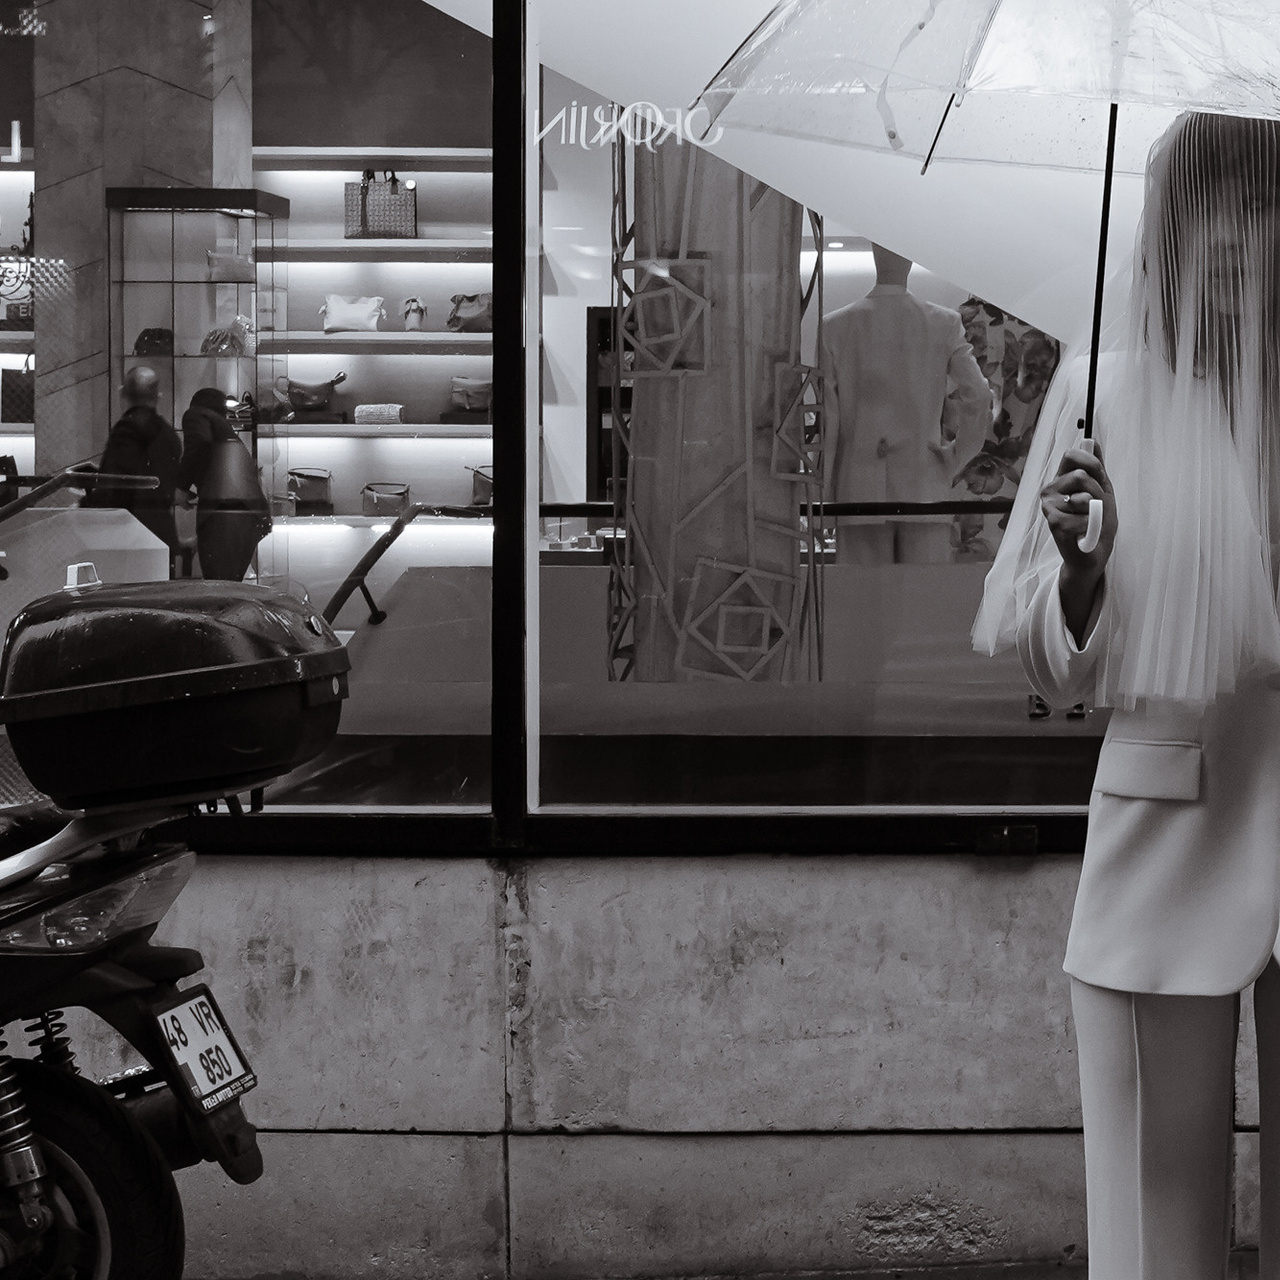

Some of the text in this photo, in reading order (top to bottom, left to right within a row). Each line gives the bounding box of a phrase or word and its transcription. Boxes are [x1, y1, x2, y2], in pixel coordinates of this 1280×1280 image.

[163, 1000, 221, 1051] 48 VR
[199, 1044, 233, 1085] 850
